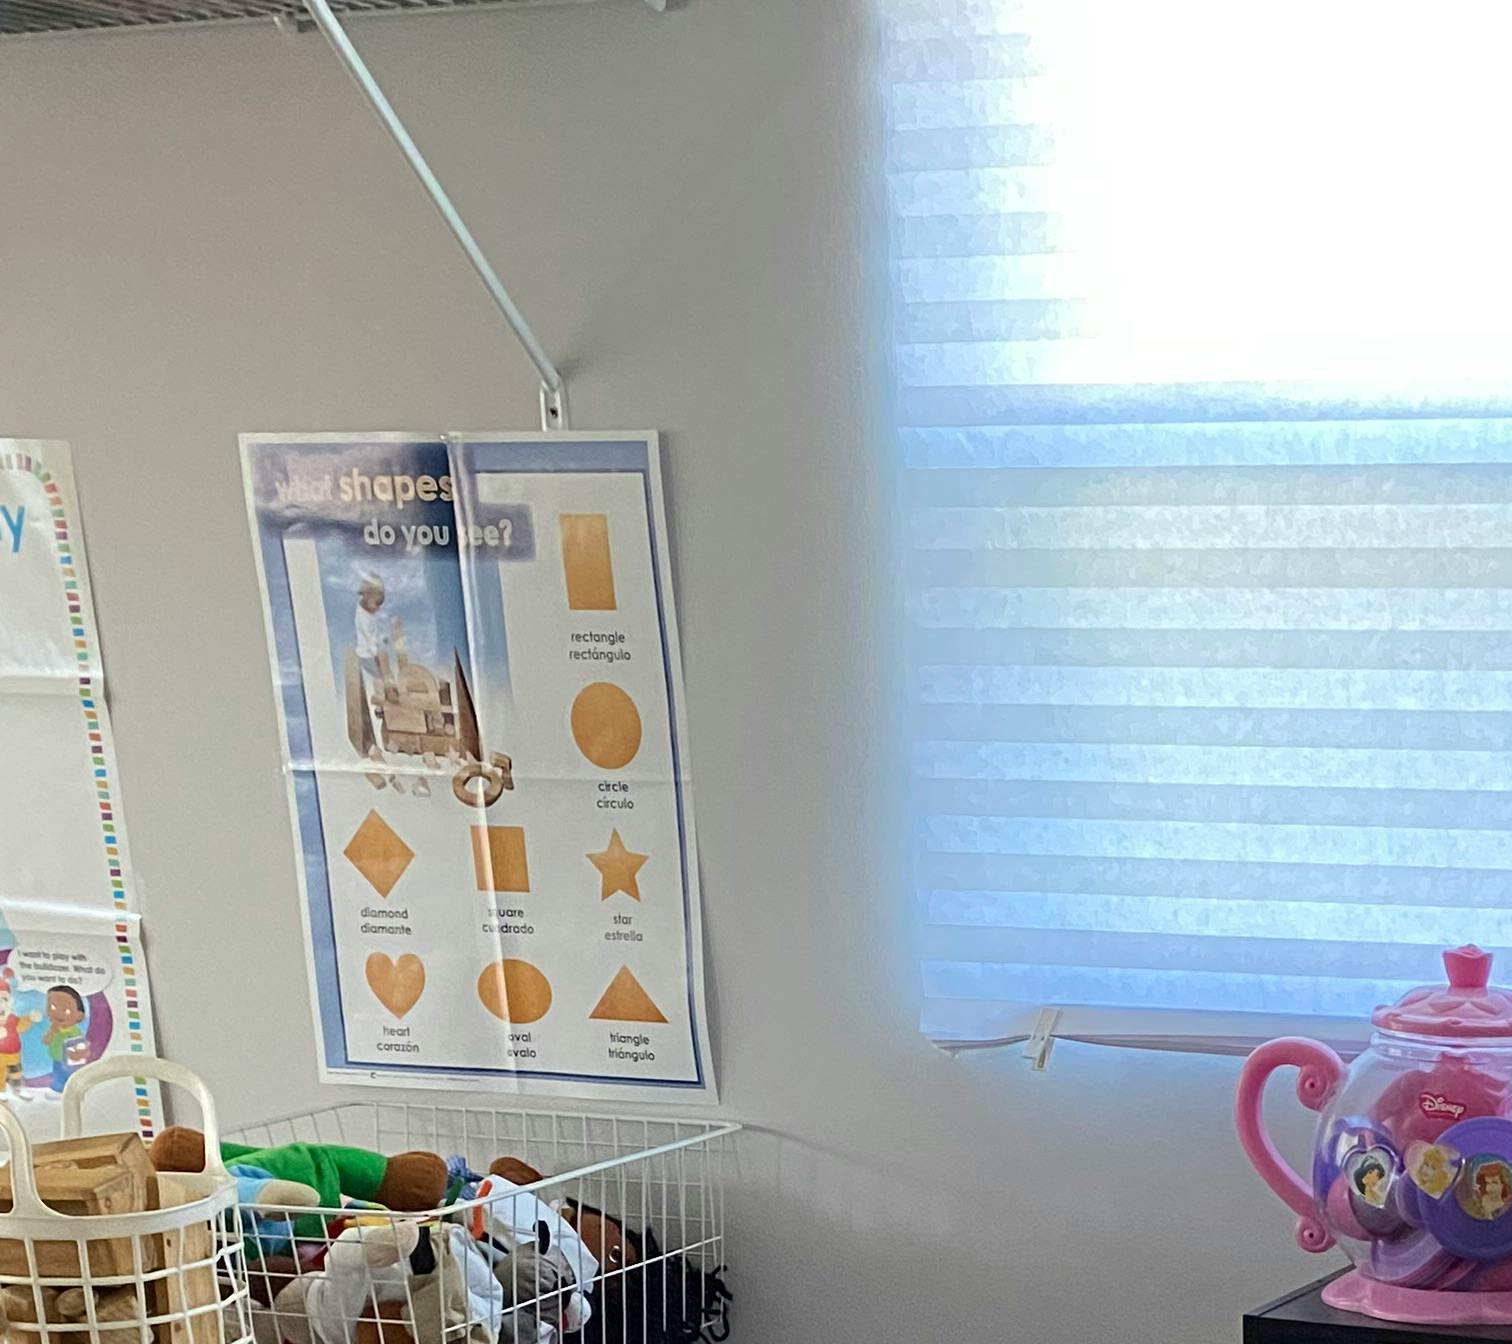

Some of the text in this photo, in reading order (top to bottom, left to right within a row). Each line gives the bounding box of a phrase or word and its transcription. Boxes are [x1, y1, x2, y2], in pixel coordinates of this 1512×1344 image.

[339, 467, 454, 509] shapes
[363, 517, 396, 546] do
[401, 523, 450, 553] you
[570, 631, 626, 646] rectangle
[569, 646, 632, 663] rectángulo
[598, 780, 630, 792] circle
[360, 906, 408, 919] diamond
[487, 907, 525, 919] suare
[613, 912, 633, 925] star
[360, 922, 412, 935] diamante
[482, 922, 535, 934] cudrado
[604, 929, 644, 942] estrella
[383, 1025, 410, 1037] heart
[508, 1031, 532, 1042] oval
[609, 1032, 650, 1046] triangle
[608, 1047, 655, 1062] triángulo
